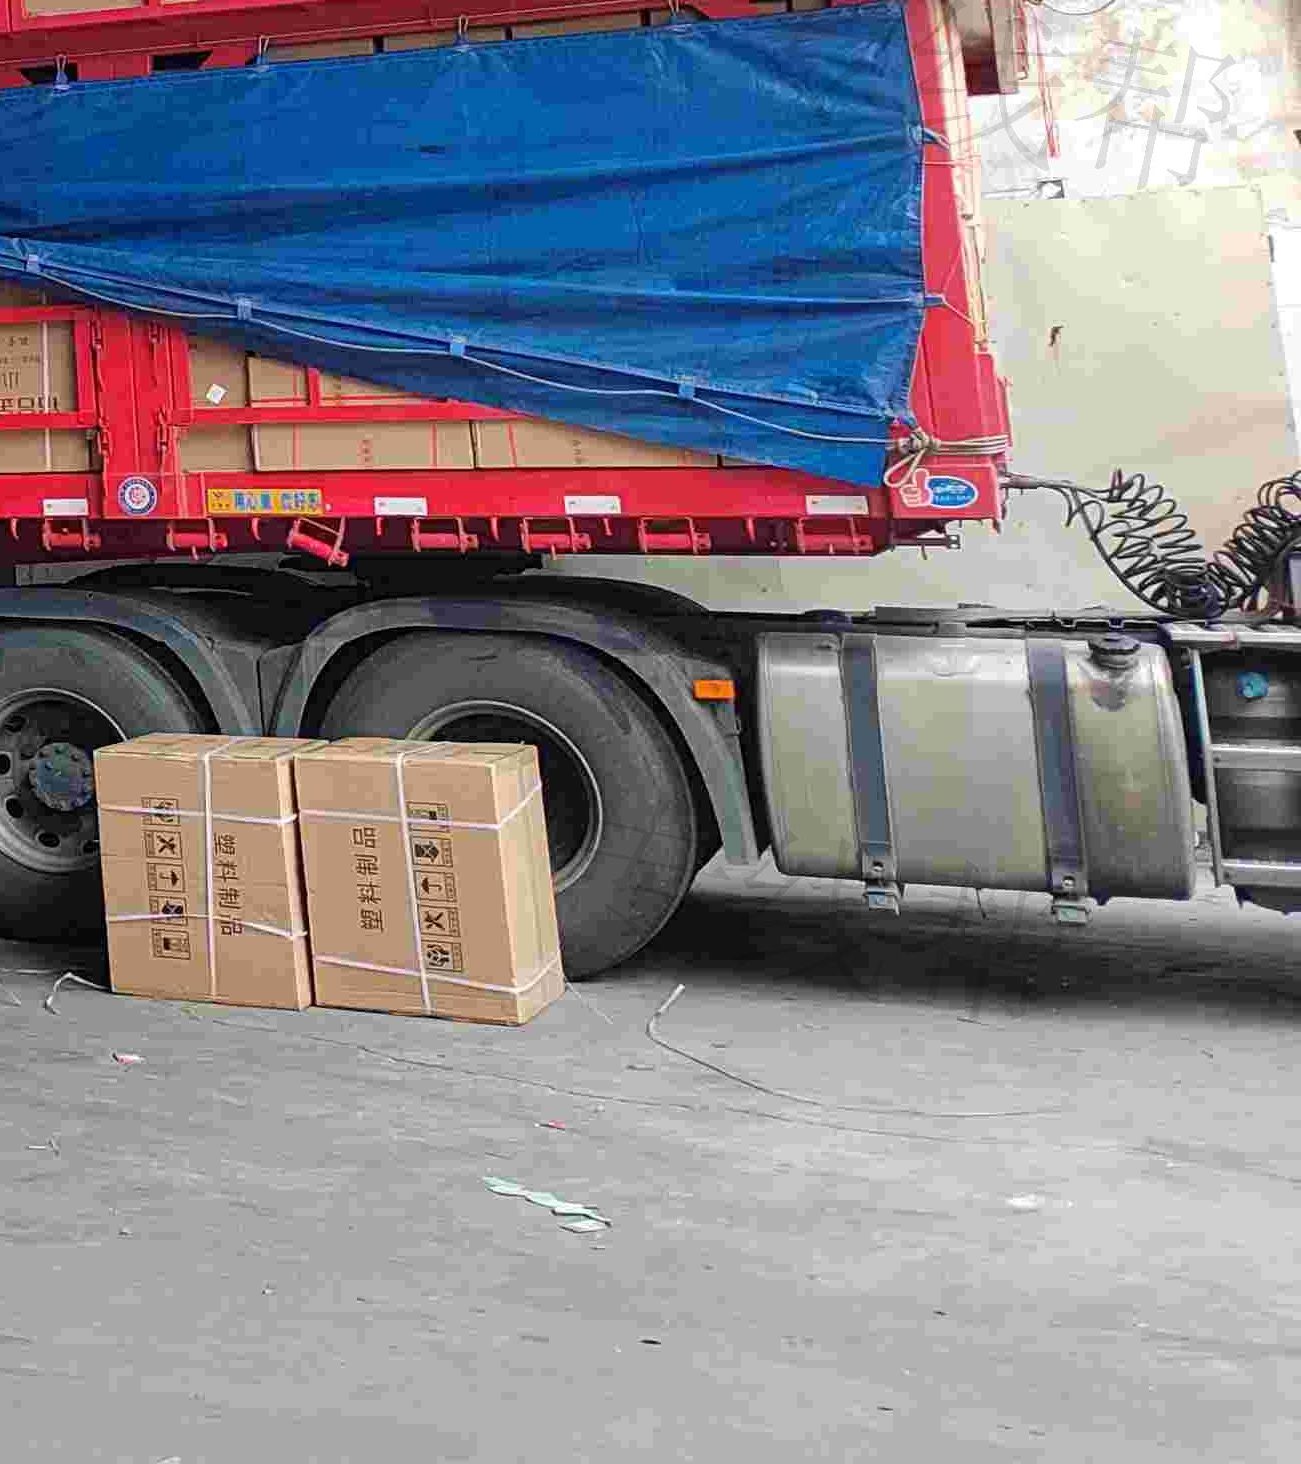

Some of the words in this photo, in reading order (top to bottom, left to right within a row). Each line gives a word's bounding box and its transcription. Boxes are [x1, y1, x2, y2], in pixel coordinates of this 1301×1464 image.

[213, 831, 246, 937] 塑料制品
[351, 826, 387, 934] 塑料制品
